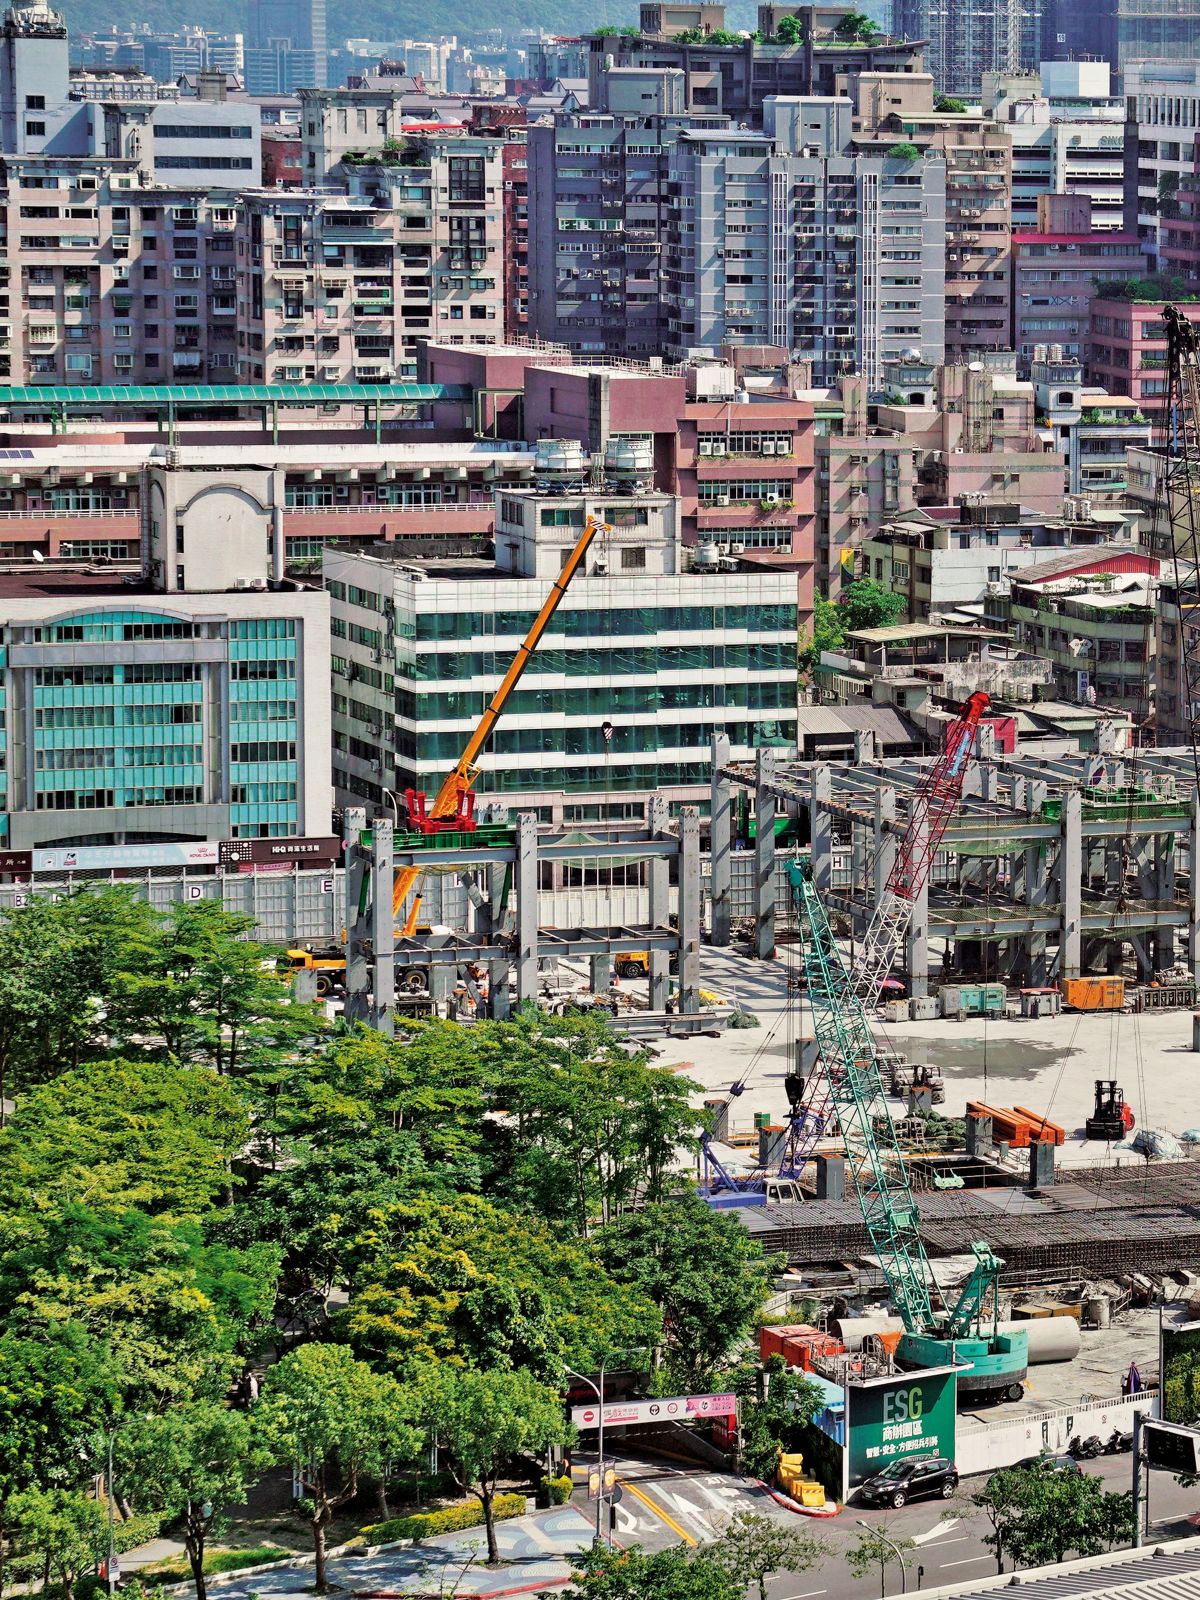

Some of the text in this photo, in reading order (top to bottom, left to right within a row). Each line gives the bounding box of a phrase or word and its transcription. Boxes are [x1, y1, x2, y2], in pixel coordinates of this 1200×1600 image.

[833, 856, 842, 868] H
[323, 880, 333, 892] E
[191, 887, 201, 898] D
[883, 1386, 923, 1425] ESG
